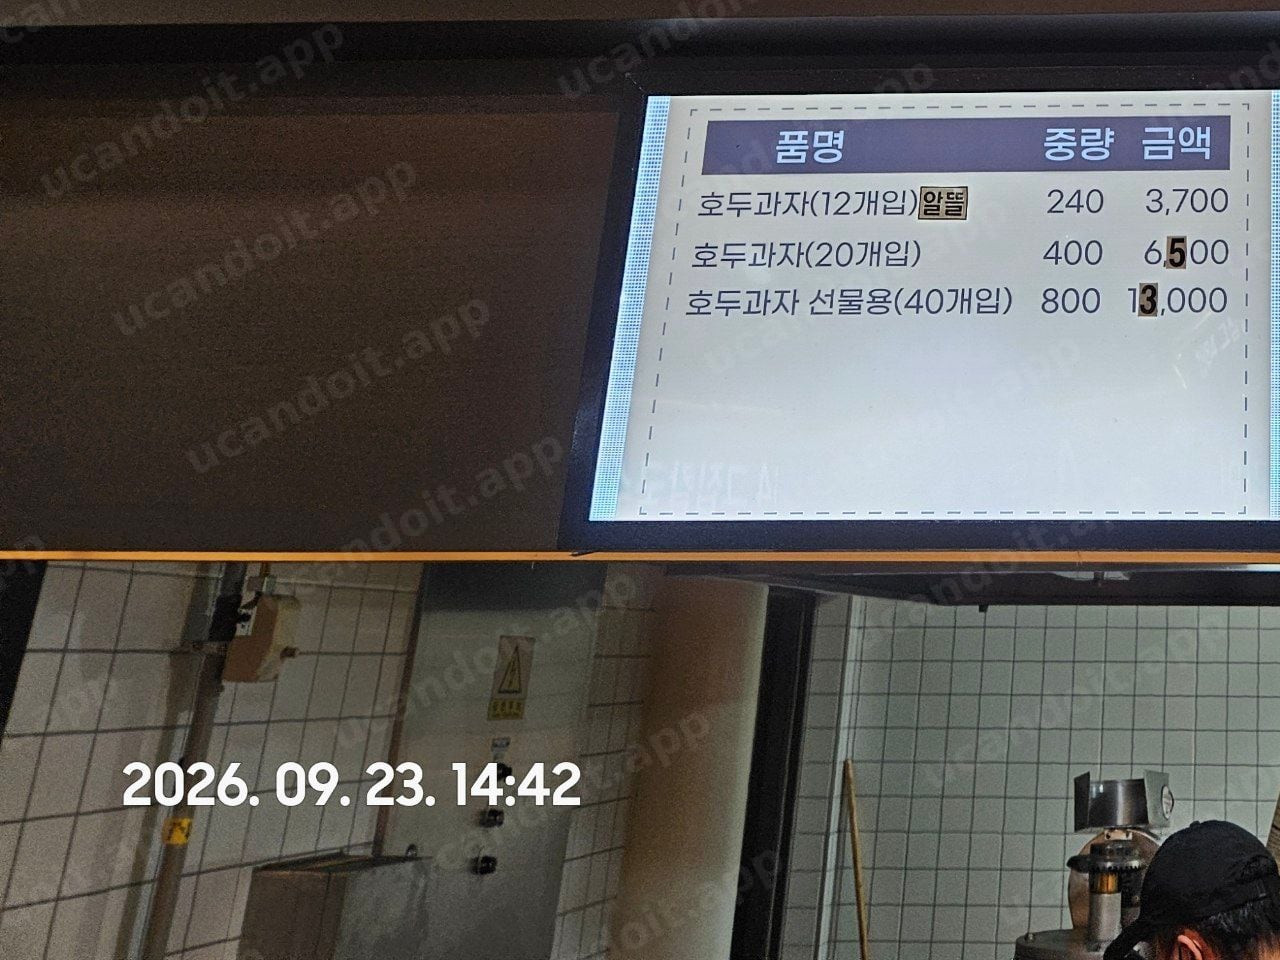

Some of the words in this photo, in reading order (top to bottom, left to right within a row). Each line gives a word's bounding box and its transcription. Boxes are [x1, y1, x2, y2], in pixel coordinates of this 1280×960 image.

[775, 130, 845, 164] 품명
[1043, 127, 1115, 162] 중량
[1141, 126, 1211, 160] 금액
[698, 190, 918, 218] 호두과자(12개입)
[920, 189, 965, 218] 알뜰
[1046, 188, 1104, 214] 240
[1145, 187, 1229, 216] 3,700
[691, 240, 921, 269] 호두과자(20개입)
[1042, 239, 1103, 266] 400
[1144, 237, 1229, 268] 6,500
[685, 288, 800, 317] 호두과자
[808, 286, 1013, 316] 선물용(40개입)
[1041, 287, 1101, 314] 800
[1128, 283, 1228, 317] 13,000
